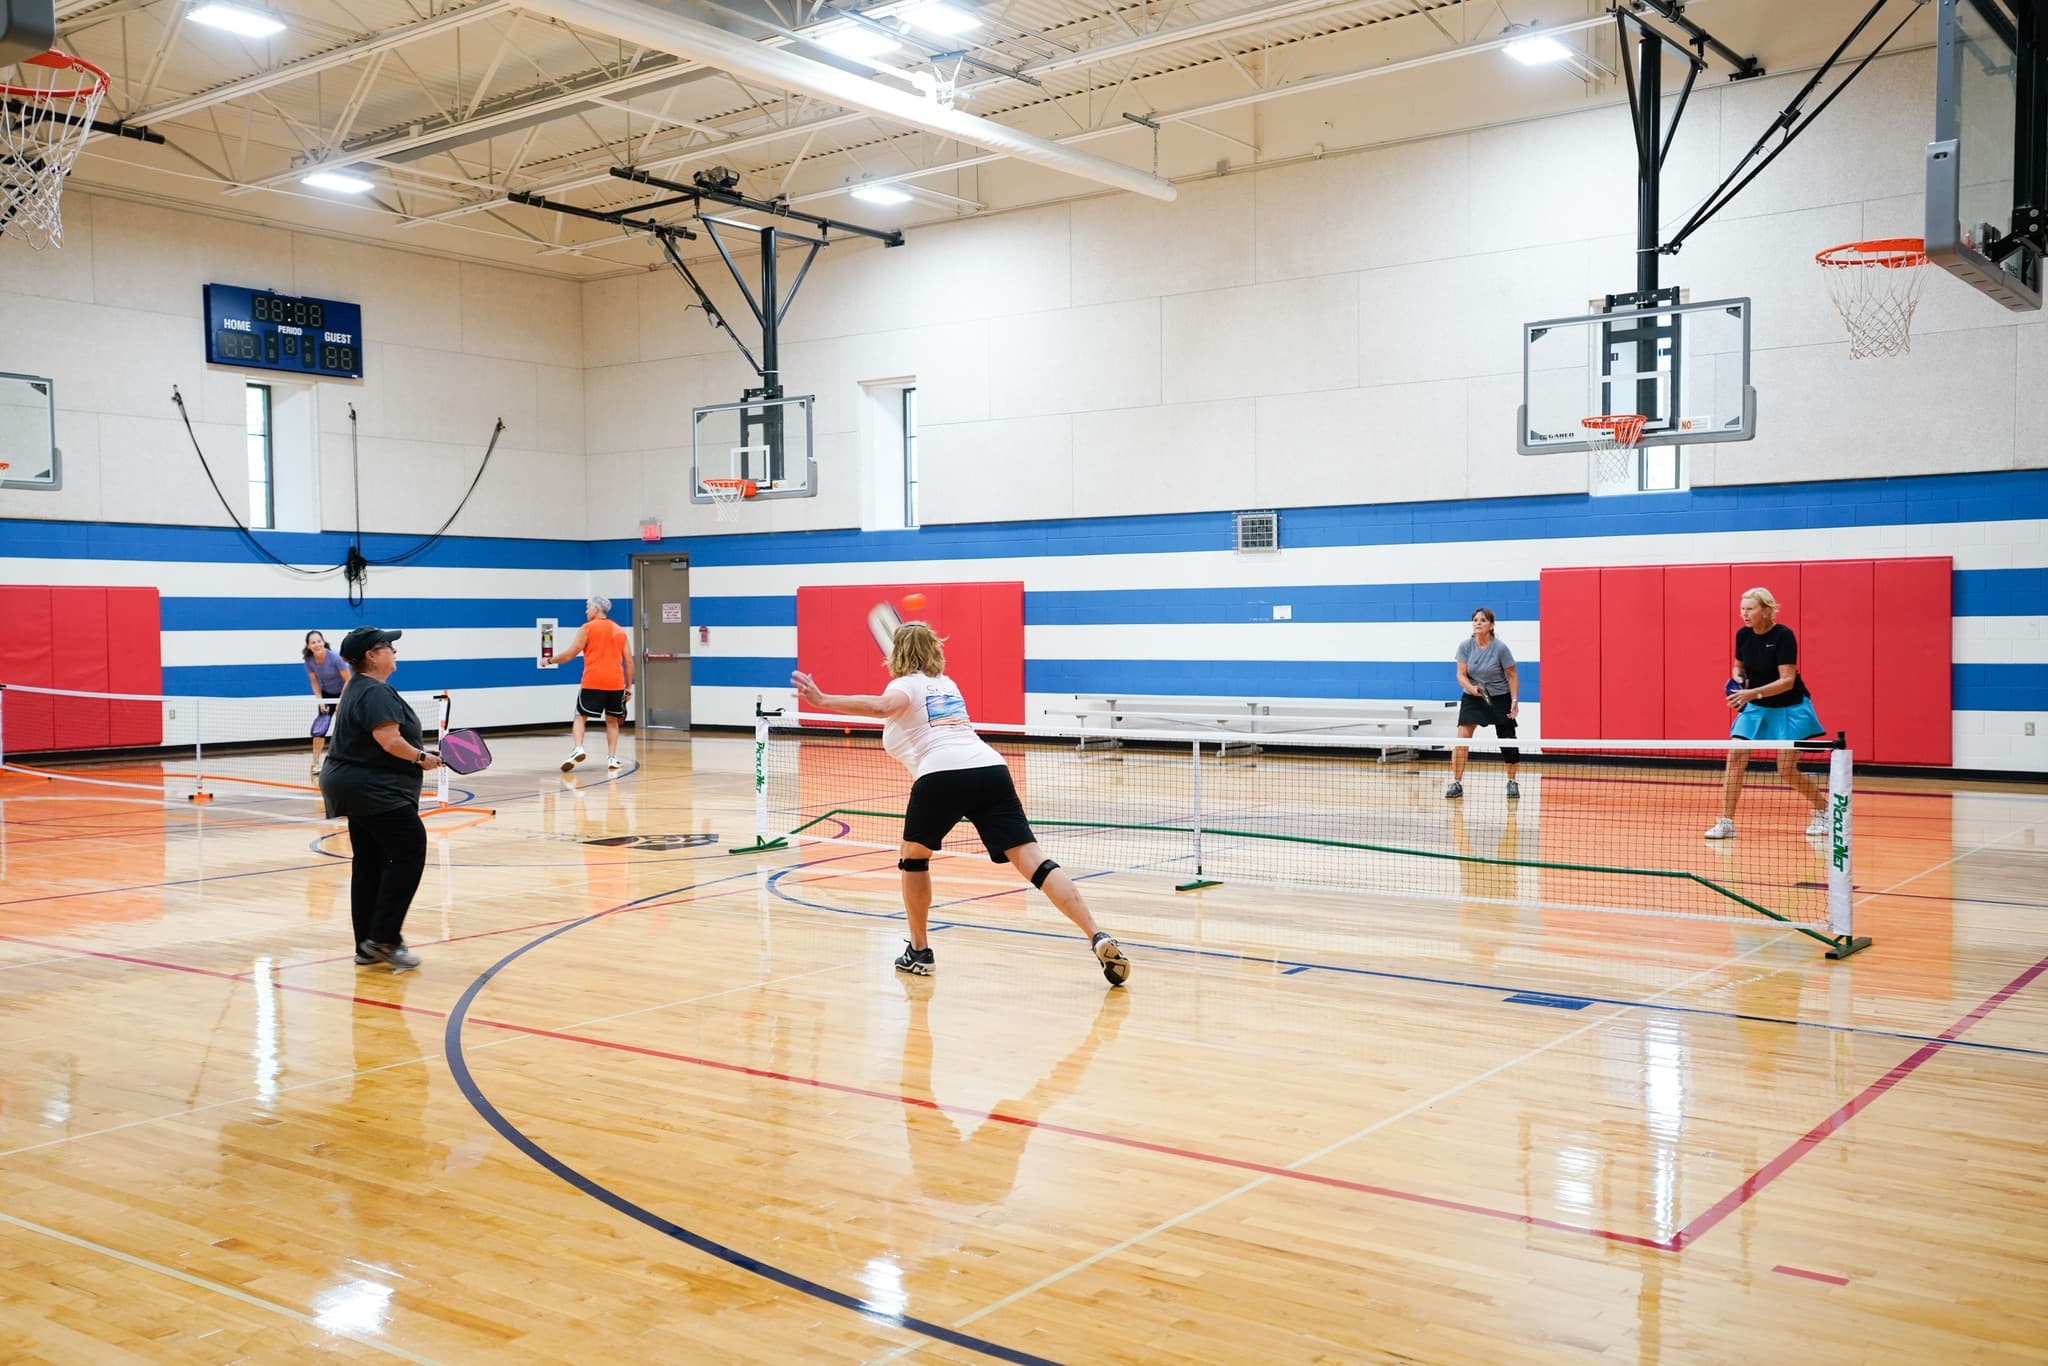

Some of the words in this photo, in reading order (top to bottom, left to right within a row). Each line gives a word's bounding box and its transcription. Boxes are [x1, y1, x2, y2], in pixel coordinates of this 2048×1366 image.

[223, 318, 252, 332] HOME
[278, 325, 302, 336] PERIOD
[324, 332, 352, 345] GUEST
[1681, 420, 1692, 430] NO
